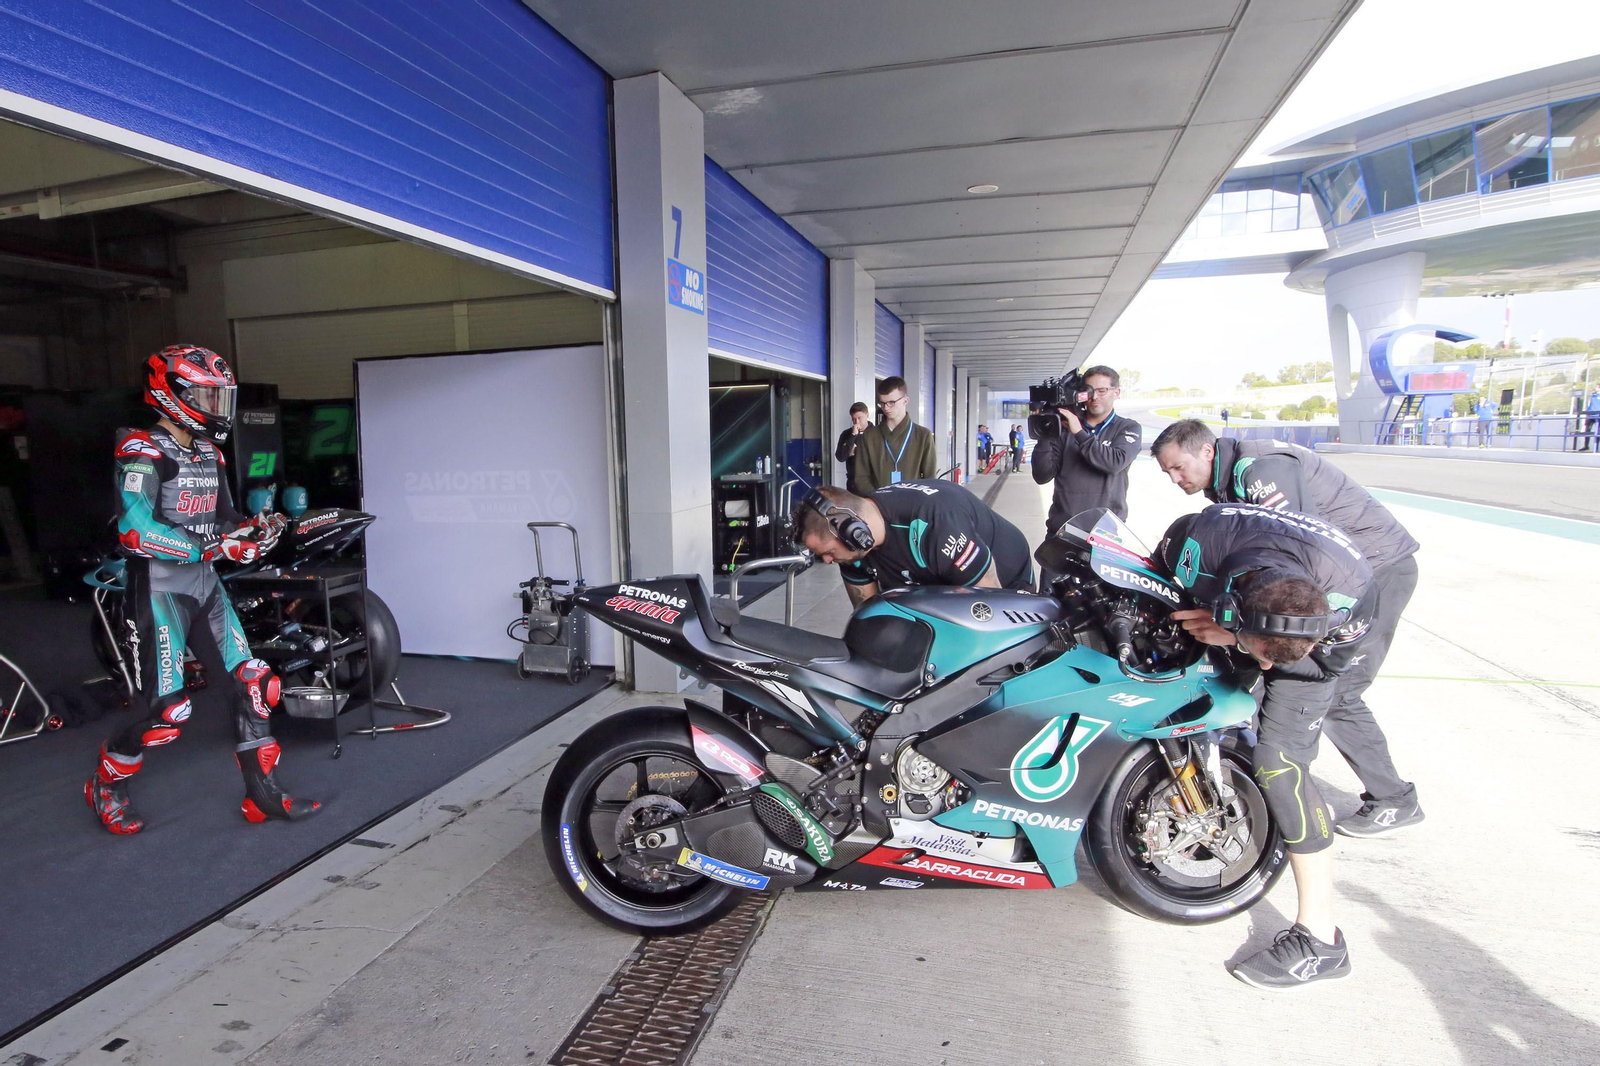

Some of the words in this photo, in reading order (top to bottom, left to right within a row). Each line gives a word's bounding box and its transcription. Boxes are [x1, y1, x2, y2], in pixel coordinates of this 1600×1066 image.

[685, 268, 700, 291] NO
[150, 389, 202, 429] SCORPION
[248, 453, 277, 477] 21
[299, 511, 339, 527] PETRONAS
[142, 542, 189, 557] BARRACUDA
[145, 531, 193, 550] PETRONAS
[1100, 564, 1181, 604] PETRONAS
[618, 584, 687, 609] PETRONAS
[605, 595, 681, 625] Sprinta
[158, 625, 173, 693] PETRONAS
[720, 750, 751, 773] RCB
[972, 800, 1084, 832] PETRONAS
[563, 827, 579, 874] MICHELIN
[908, 836, 972, 856] Malaysia
[940, 834, 966, 847] Visit
[763, 848, 798, 870] RK
[703, 862, 761, 885] MICHELIN
[902, 859, 1026, 886] BARRACUDA
